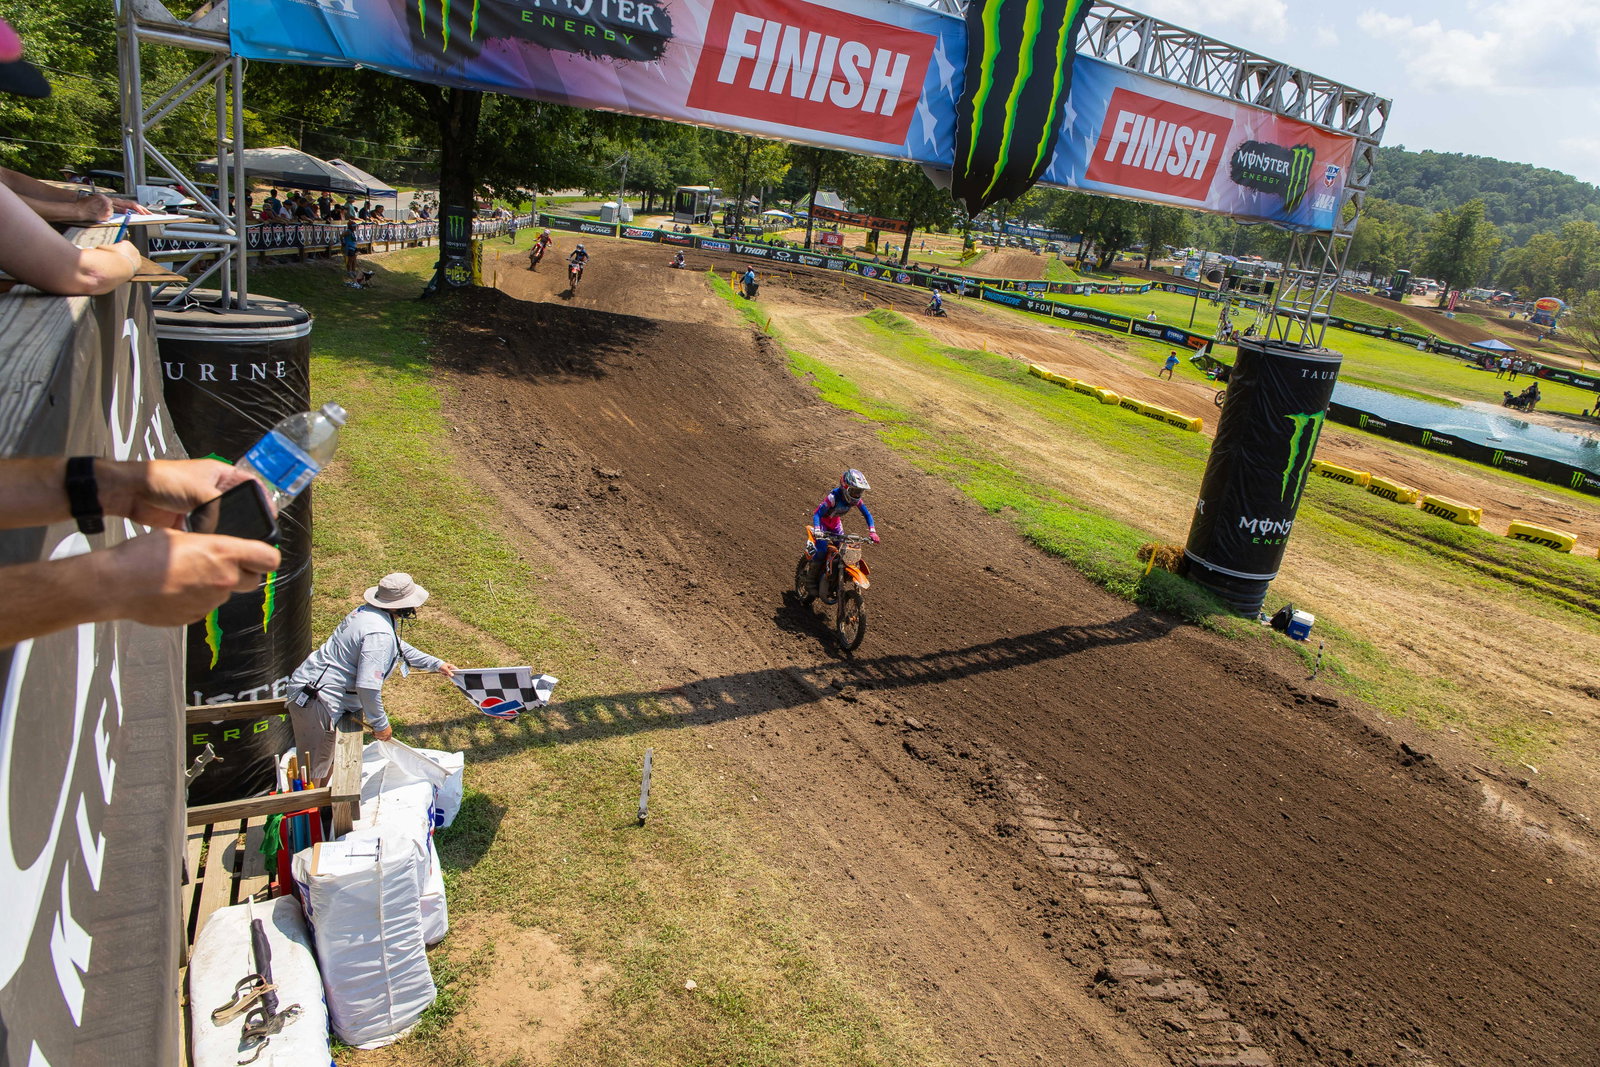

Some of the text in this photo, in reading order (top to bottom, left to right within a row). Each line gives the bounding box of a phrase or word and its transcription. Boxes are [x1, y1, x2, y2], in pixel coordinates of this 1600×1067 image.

[521, 10, 635, 45] ENERGY
[717, 12, 911, 117] FINISH
[1104, 110, 1216, 180] FINISH
[1243, 172, 1280, 185] ENERGY
[622, 228, 654, 238] AMSOIL
[744, 246, 768, 256] THOR
[446, 268, 472, 277] DIRTY
[1035, 303, 1050, 312] FOX
[1371, 484, 1398, 501] THOR
[1422, 502, 1458, 521] THOR
